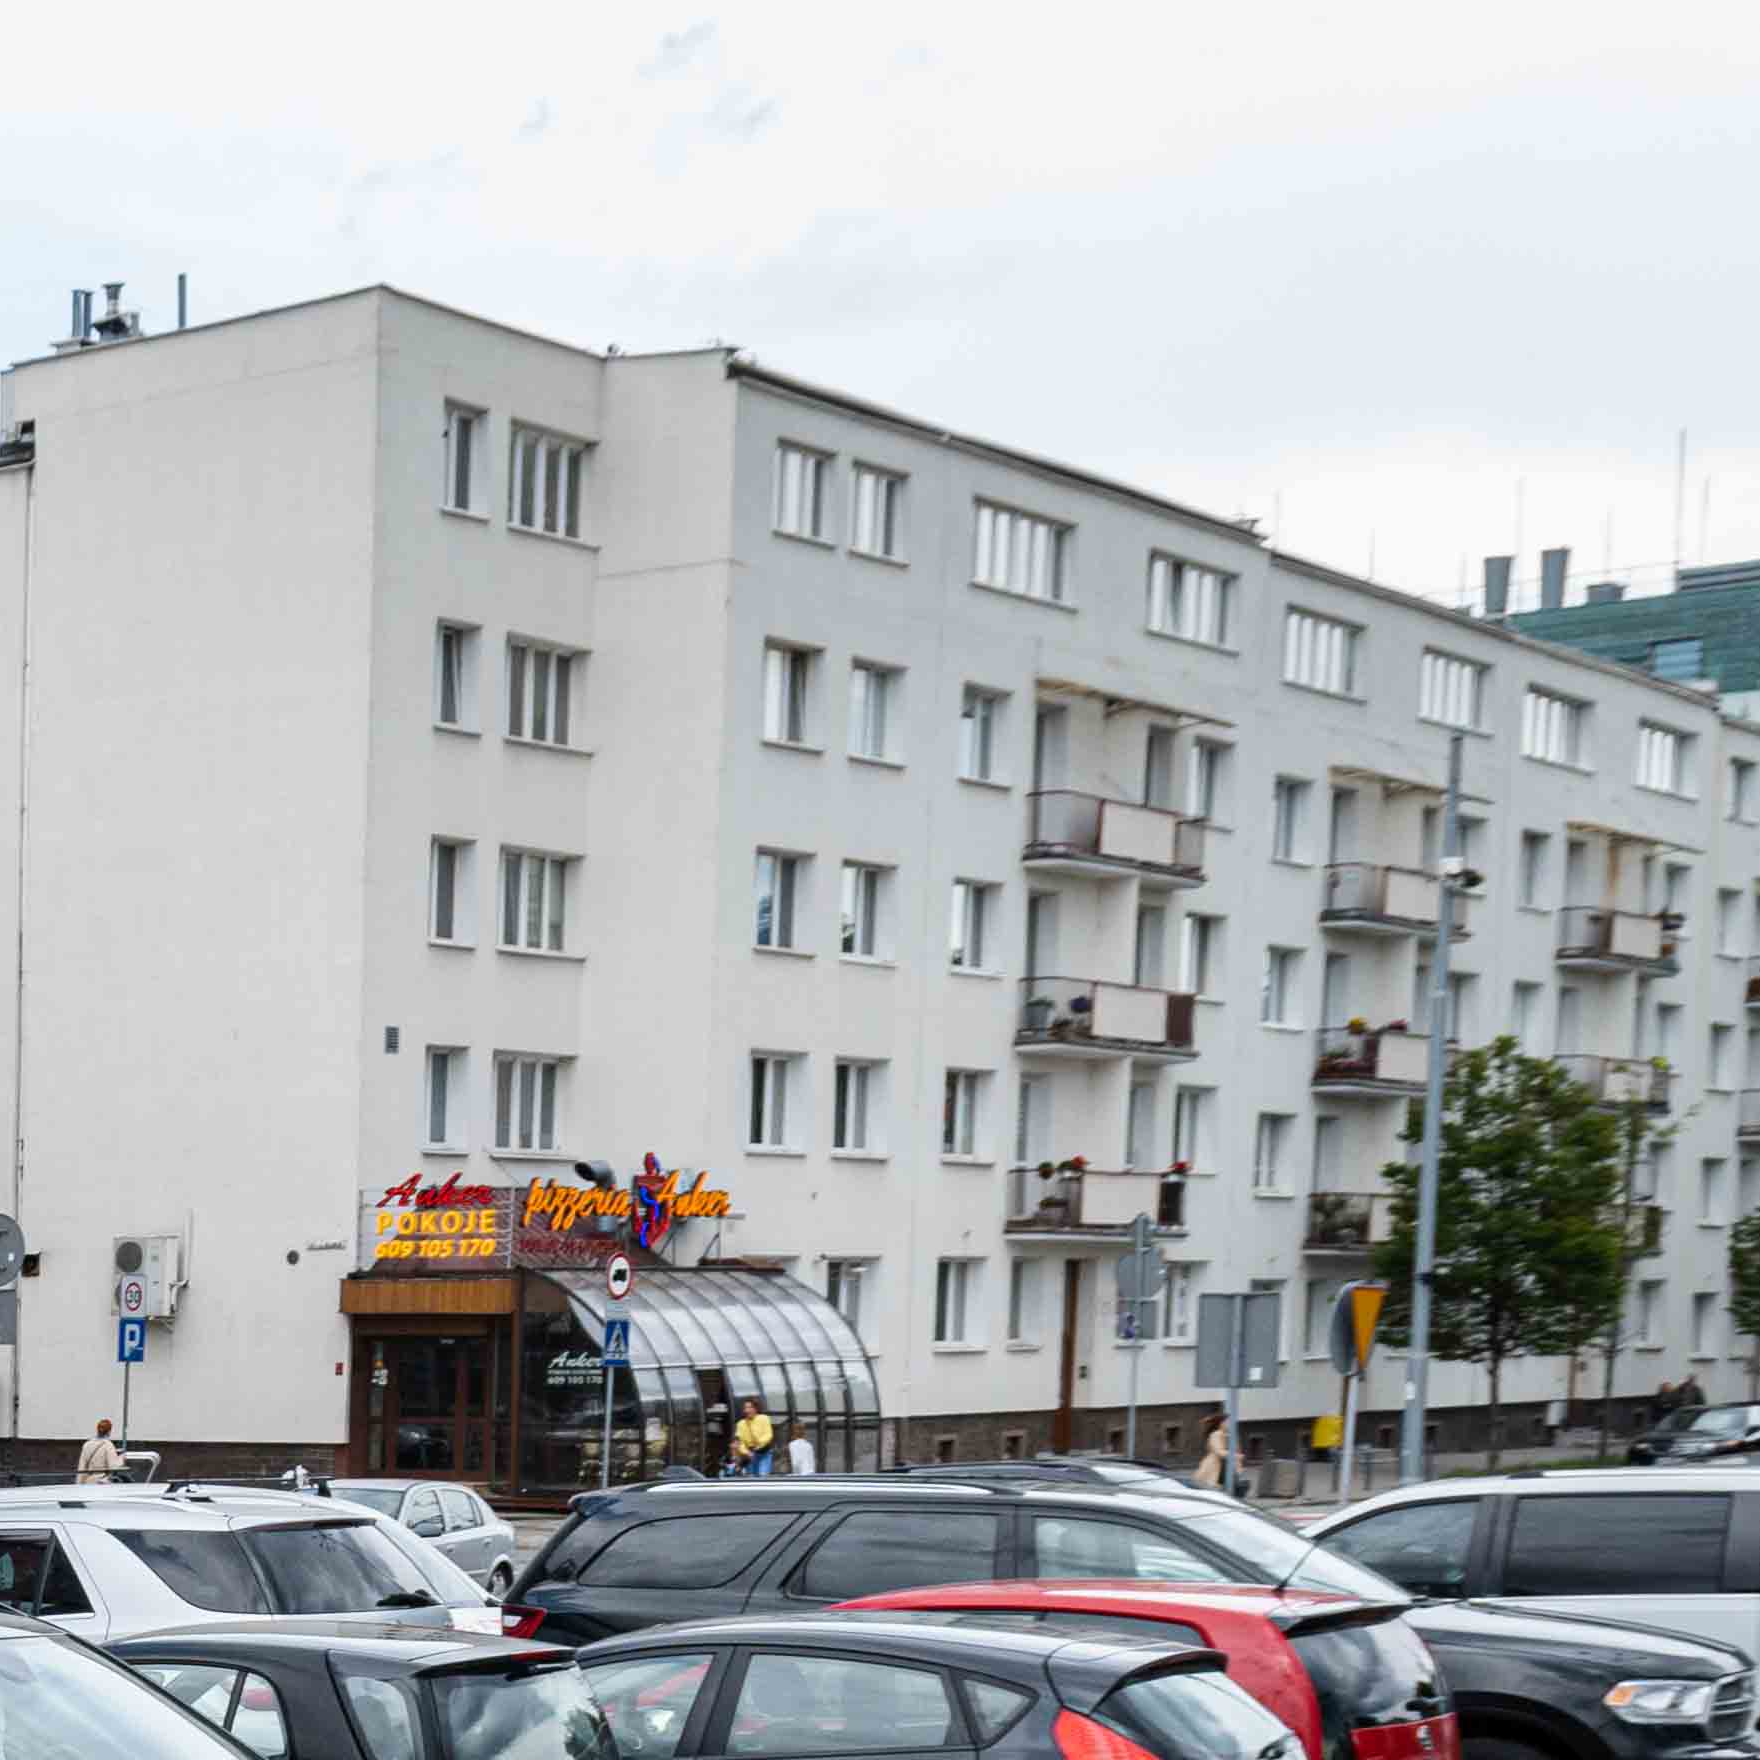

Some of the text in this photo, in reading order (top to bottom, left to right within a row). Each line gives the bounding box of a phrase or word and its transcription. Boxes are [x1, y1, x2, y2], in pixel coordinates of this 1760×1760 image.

[523, 1169, 731, 1232] pizzeria Anker
[376, 1208, 496, 1236] POKOJE
[375, 1239, 415, 1259] 609
[418, 1239, 453, 1258] 105
[459, 1238, 496, 1258] 170
